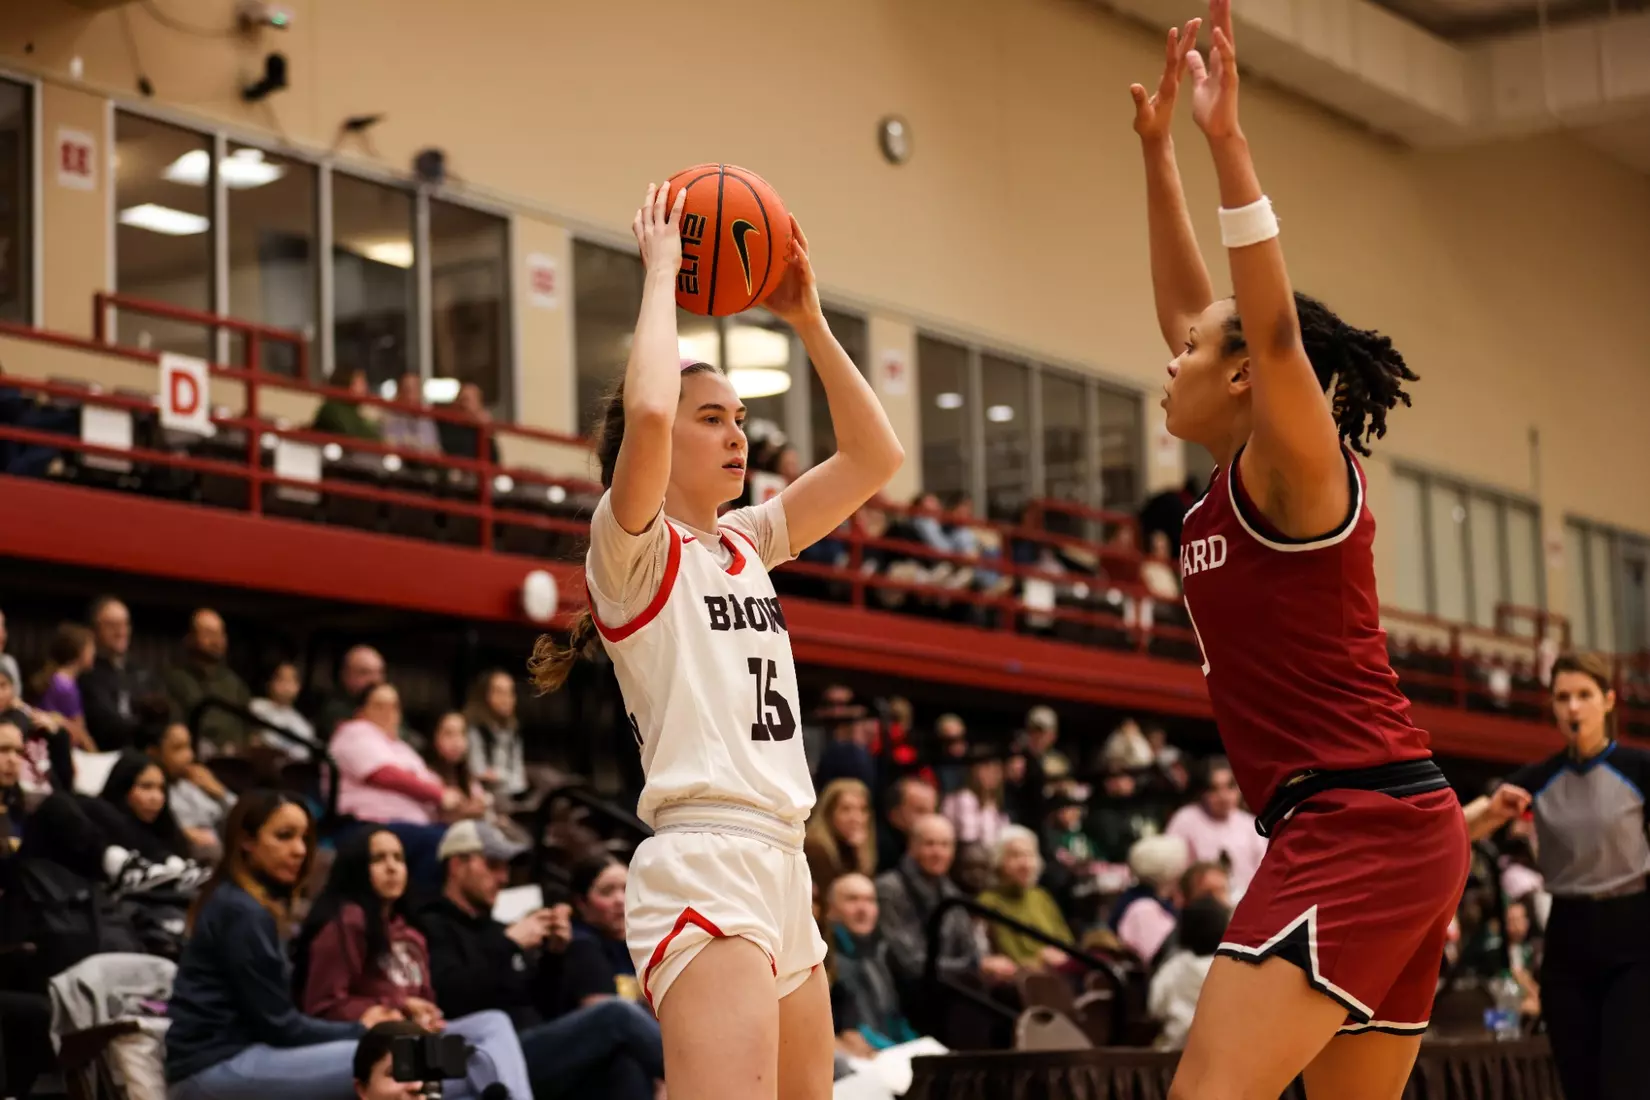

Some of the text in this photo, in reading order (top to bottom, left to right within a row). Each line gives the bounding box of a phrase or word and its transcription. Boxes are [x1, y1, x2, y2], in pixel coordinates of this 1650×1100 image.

[678, 212, 708, 295] ELITE
[170, 369, 200, 416] D
[747, 657, 796, 741] 15
